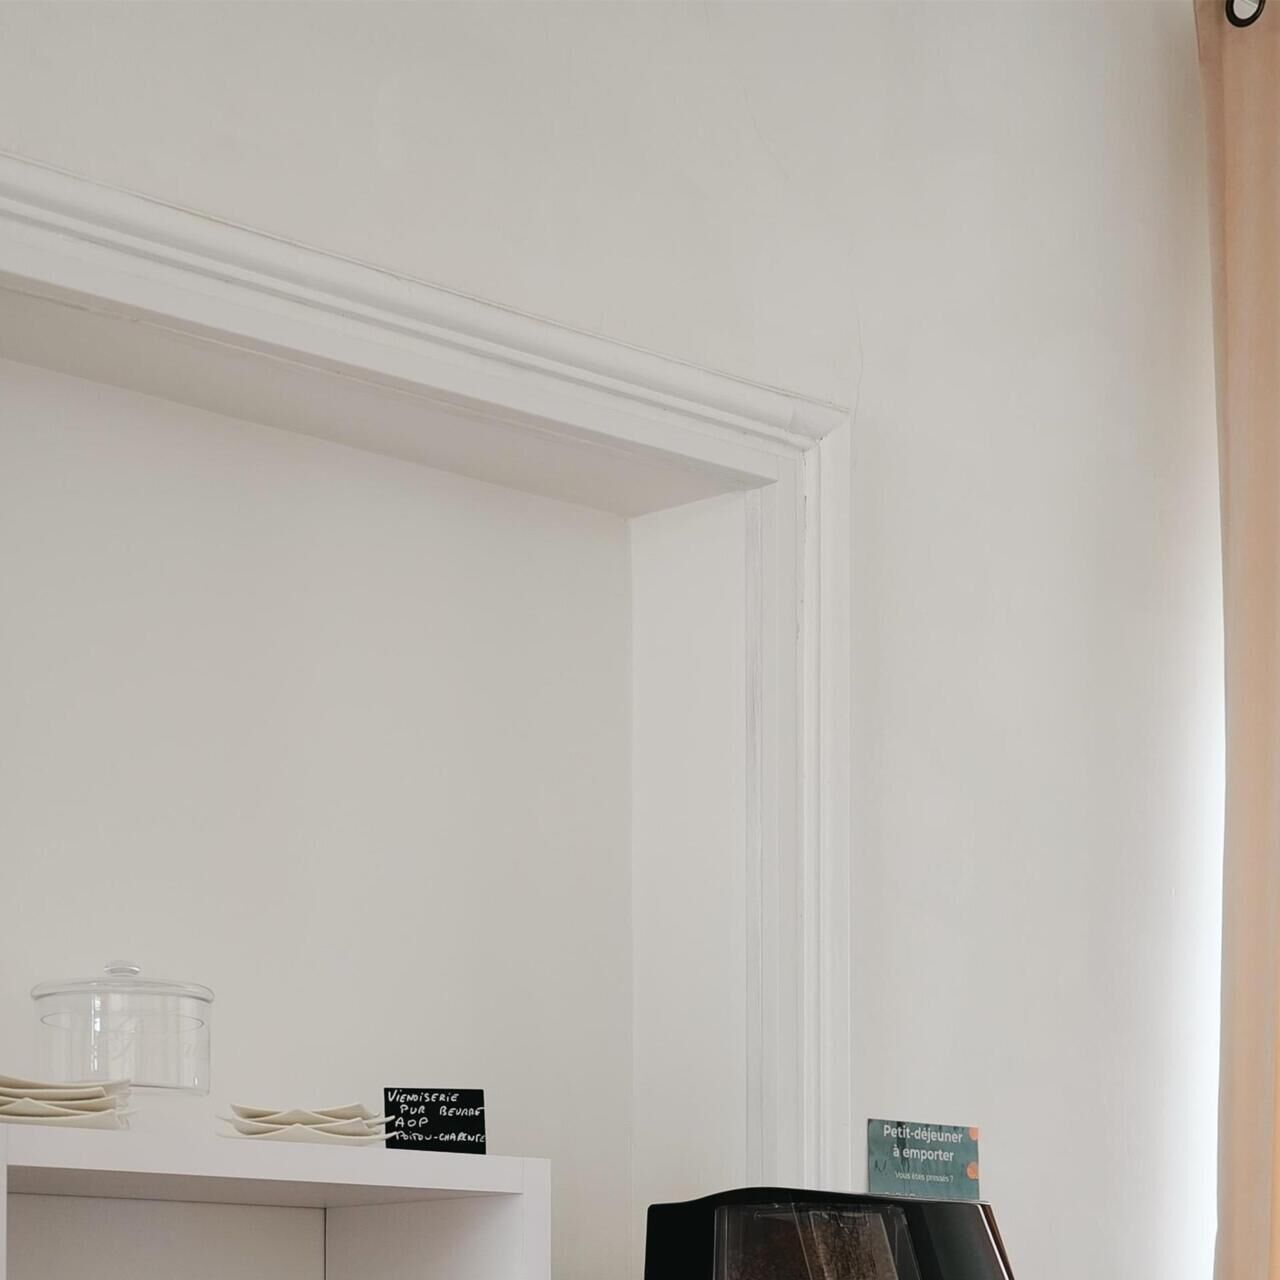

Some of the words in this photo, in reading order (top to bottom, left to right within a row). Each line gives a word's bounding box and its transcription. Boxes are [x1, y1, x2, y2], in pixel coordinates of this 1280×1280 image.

[399, 1103, 426, 1116] PUR
[394, 1115, 429, 1128] AOP
[883, 1123, 963, 1144] Petit-déjeuner
[892, 1143, 900, 1157] à
[902, 1146, 955, 1162] emporter
